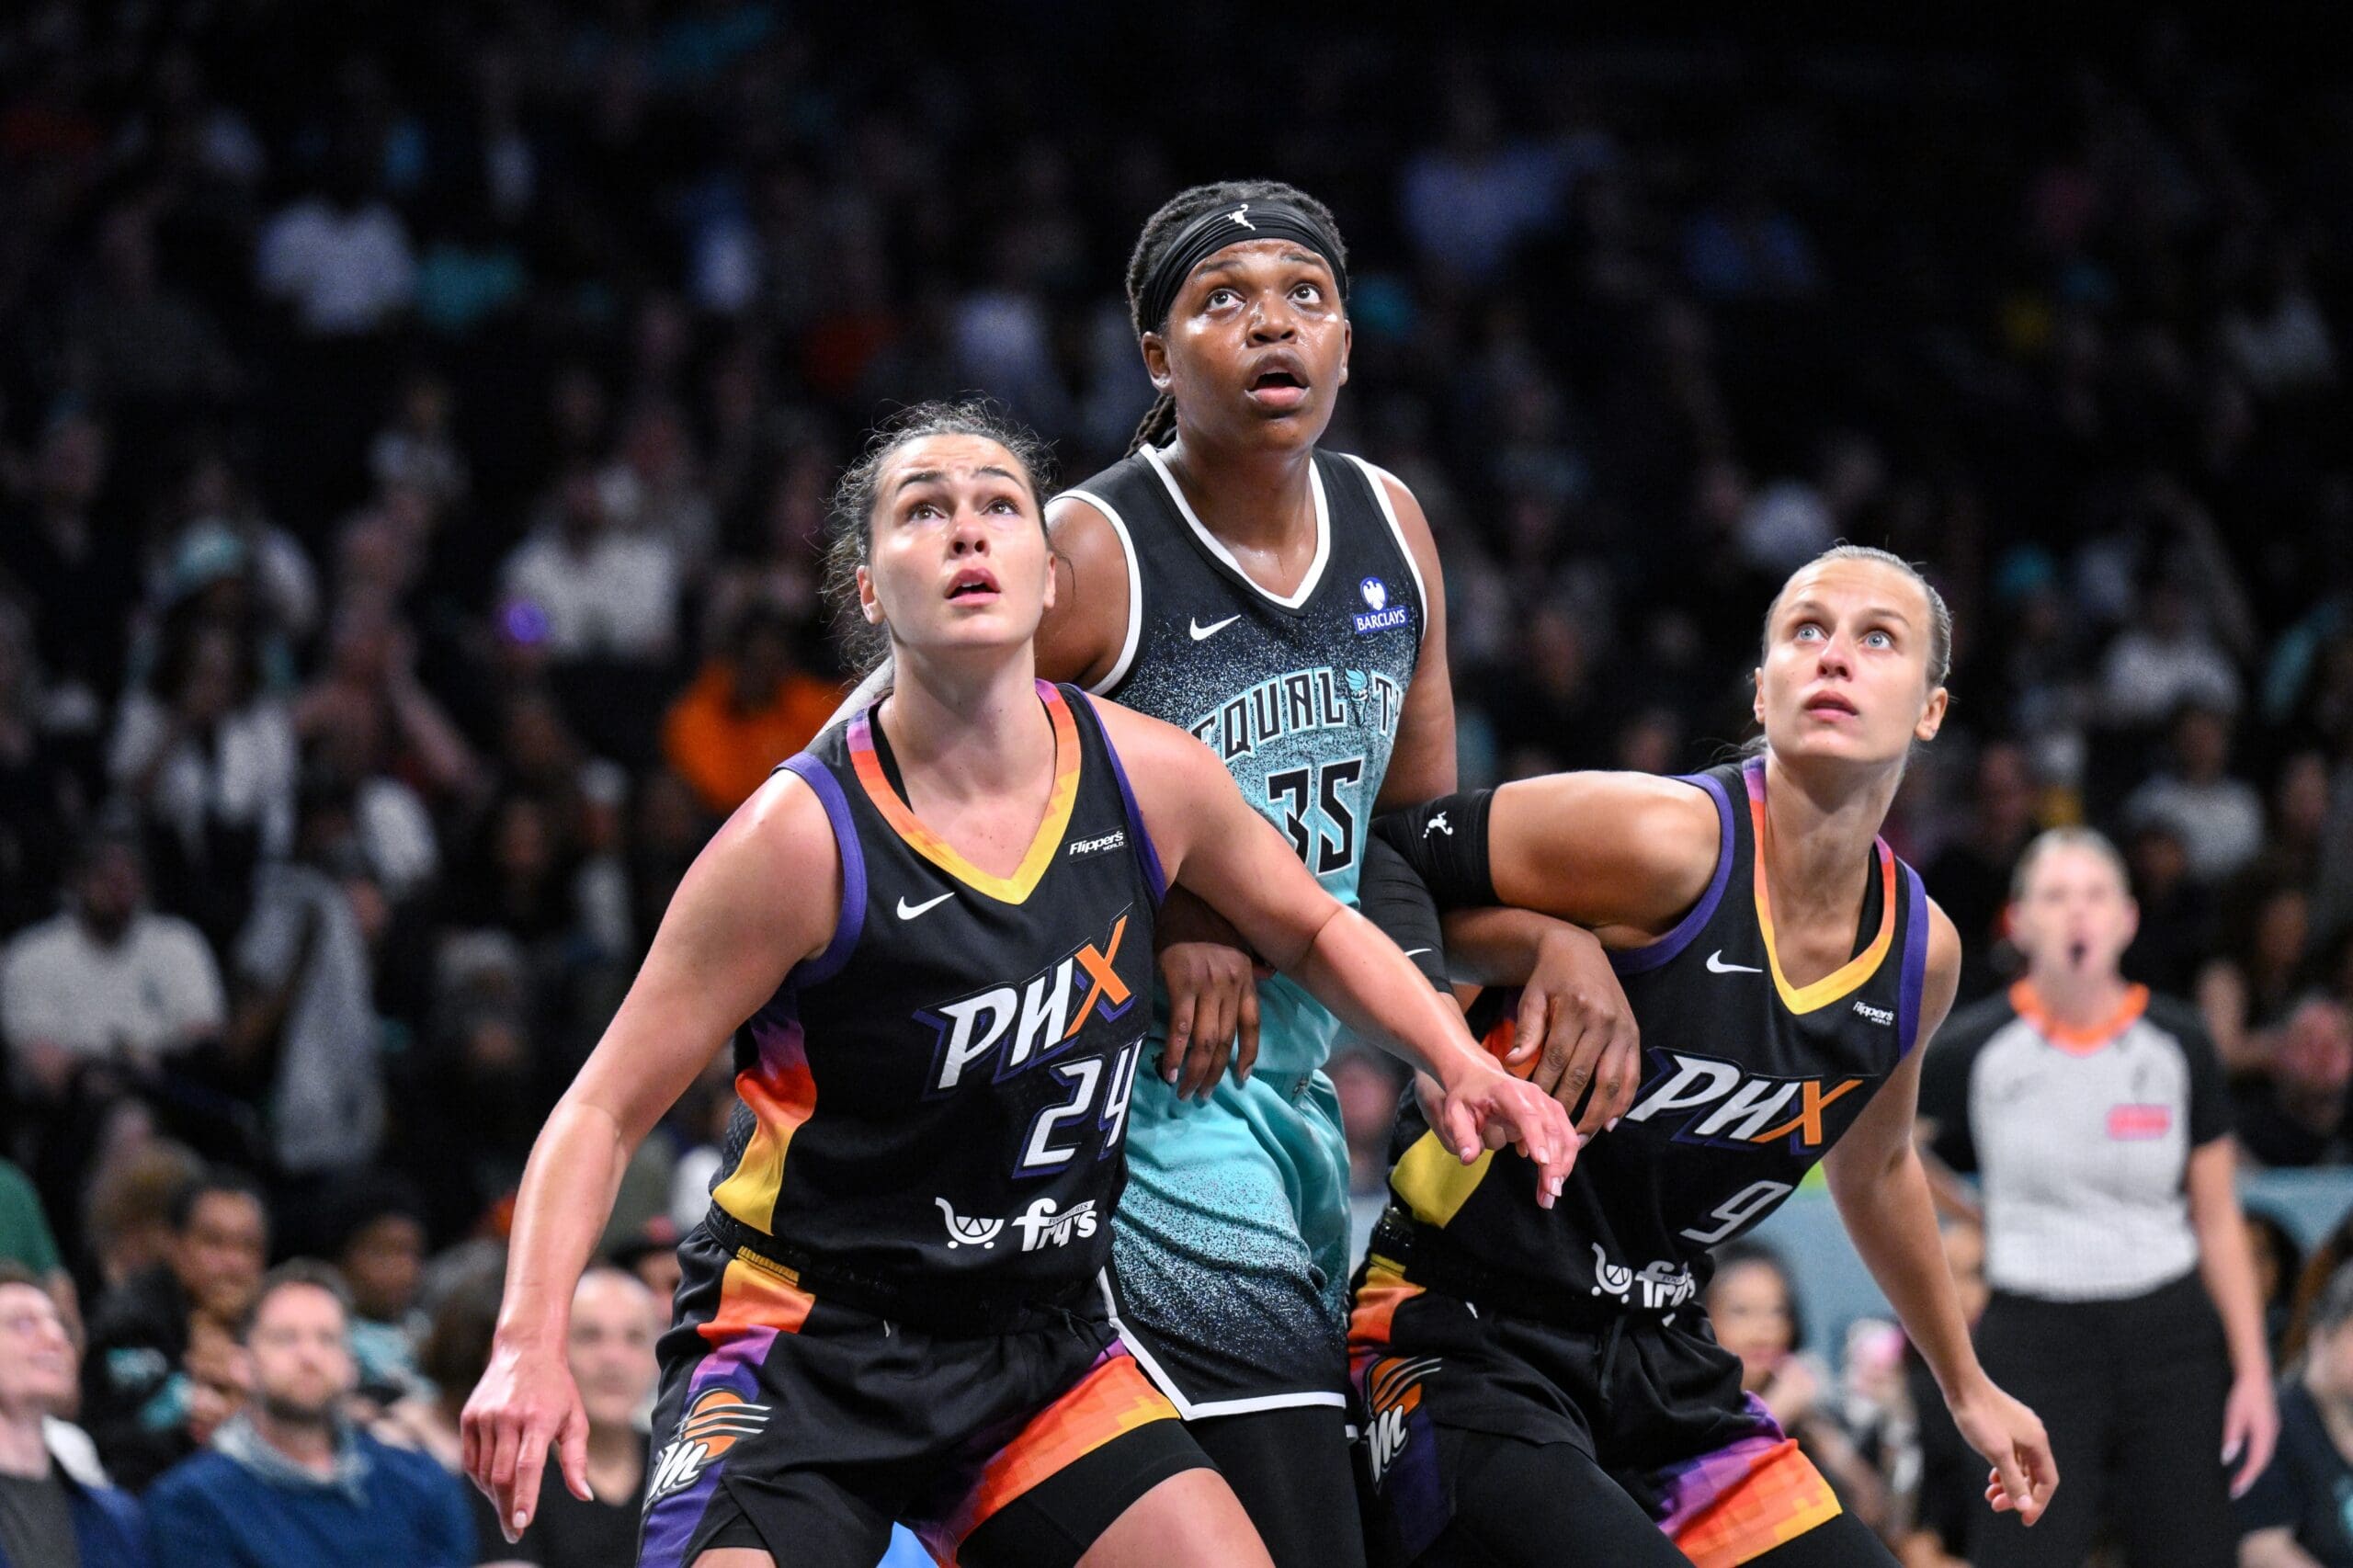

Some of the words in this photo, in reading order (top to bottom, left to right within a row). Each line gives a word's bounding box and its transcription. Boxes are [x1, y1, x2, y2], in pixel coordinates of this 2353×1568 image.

[1356, 608, 1405, 631] BARCLAYS
[1267, 758, 1362, 874] 35
[936, 914, 1132, 1091] PHX
[1021, 1039, 1144, 1168] 24
[1624, 1054, 1864, 1146] PHX
[1678, 1179, 1794, 1244] 9
